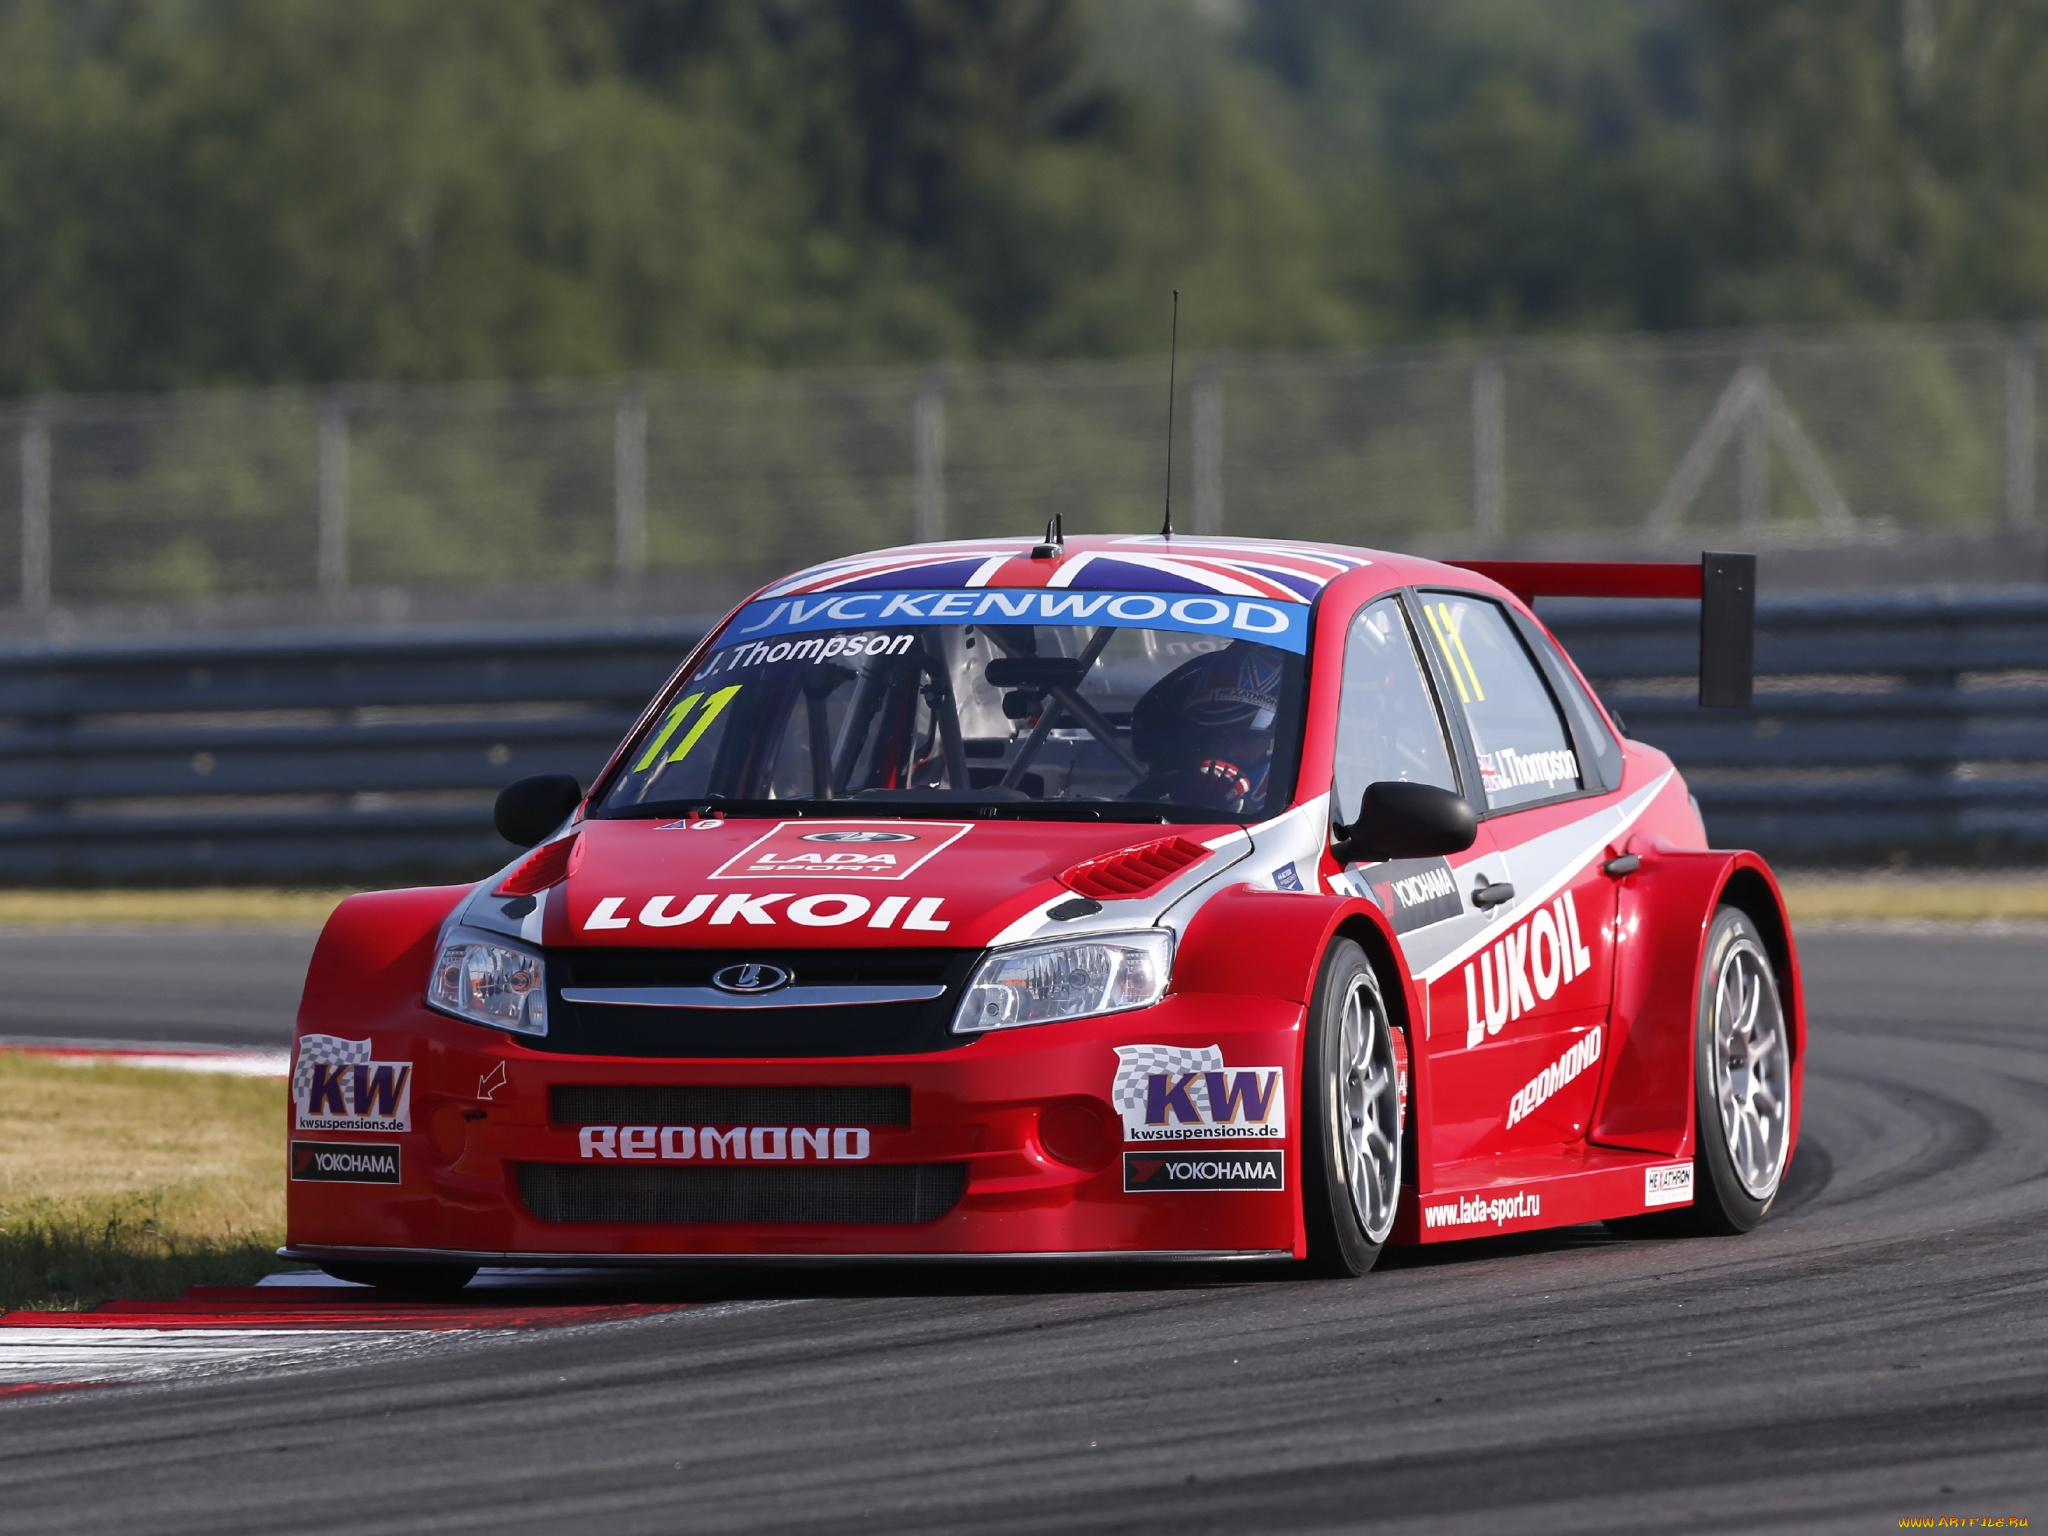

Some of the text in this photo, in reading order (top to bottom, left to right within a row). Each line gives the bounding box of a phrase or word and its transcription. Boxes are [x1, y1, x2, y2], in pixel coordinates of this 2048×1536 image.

[740, 593, 1289, 633] JVC KENWOOD
[1423, 602, 1486, 703] 11
[632, 684, 743, 774] 11
[756, 853, 897, 865] LADA
[1391, 867, 1456, 909] YOKOHAMA
[583, 893, 951, 931] LUKOIL
[1464, 889, 1591, 1050] LUKOIL
[308, 1063, 412, 1118] KW
[1145, 1070, 1282, 1126] KW
[300, 1116, 404, 1131] kwsuspensions.de
[1130, 1124, 1279, 1141] kwsuspensions.de
[315, 1152, 396, 1174] YOKOHAMA
[1165, 1161, 1277, 1180] YOKOHAMA
[1424, 1190, 1540, 1228] www.lada-sport.ru
